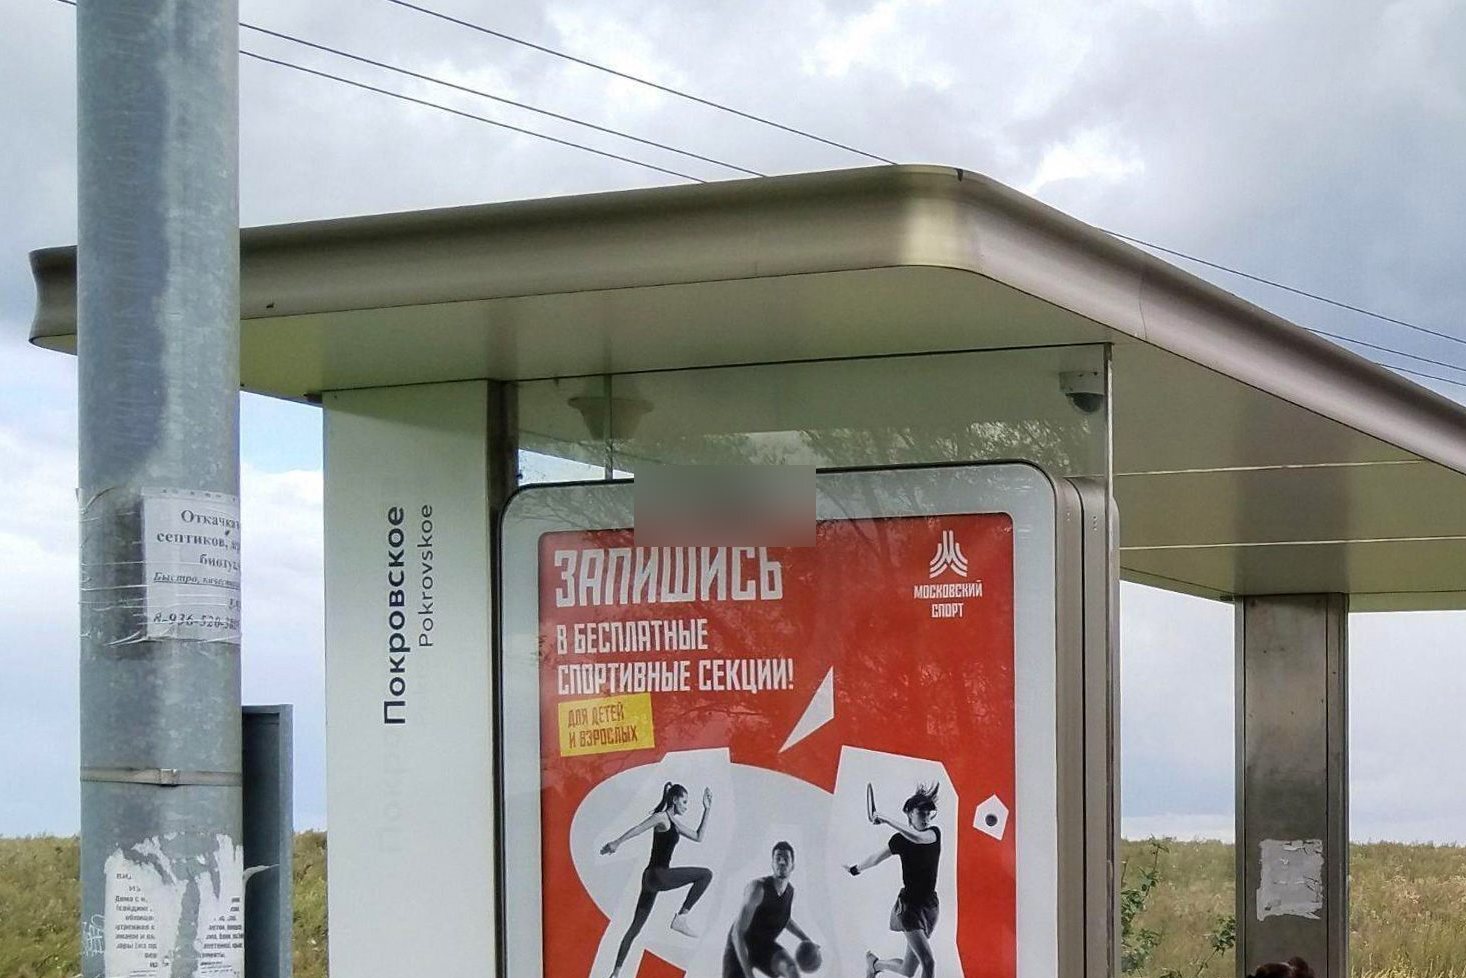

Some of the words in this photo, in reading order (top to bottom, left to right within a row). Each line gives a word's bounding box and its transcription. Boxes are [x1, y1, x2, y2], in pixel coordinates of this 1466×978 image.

[417, 504, 434, 648] Pokrovskoe
[554, 546, 783, 607] ЗАПИШИСЬ
[914, 580, 983, 599] МОСКОВСКИЙ
[383, 506, 411, 725] Покровское
[931, 602, 964, 618] СПОРТ
[556, 624, 568, 655] В
[574, 618, 708, 654] БЕСПЛАТНЫЕ
[558, 660, 691, 695] СПОРТИВНЫЕ
[698, 658, 794, 694] СЕКЦИИ!
[568, 707, 588, 728] ДЛЯ
[591, 702, 625, 726] ДЕТЕЙ
[569, 730, 576, 749] И
[579, 725, 638, 748] ВЗРОСЛЫХ
